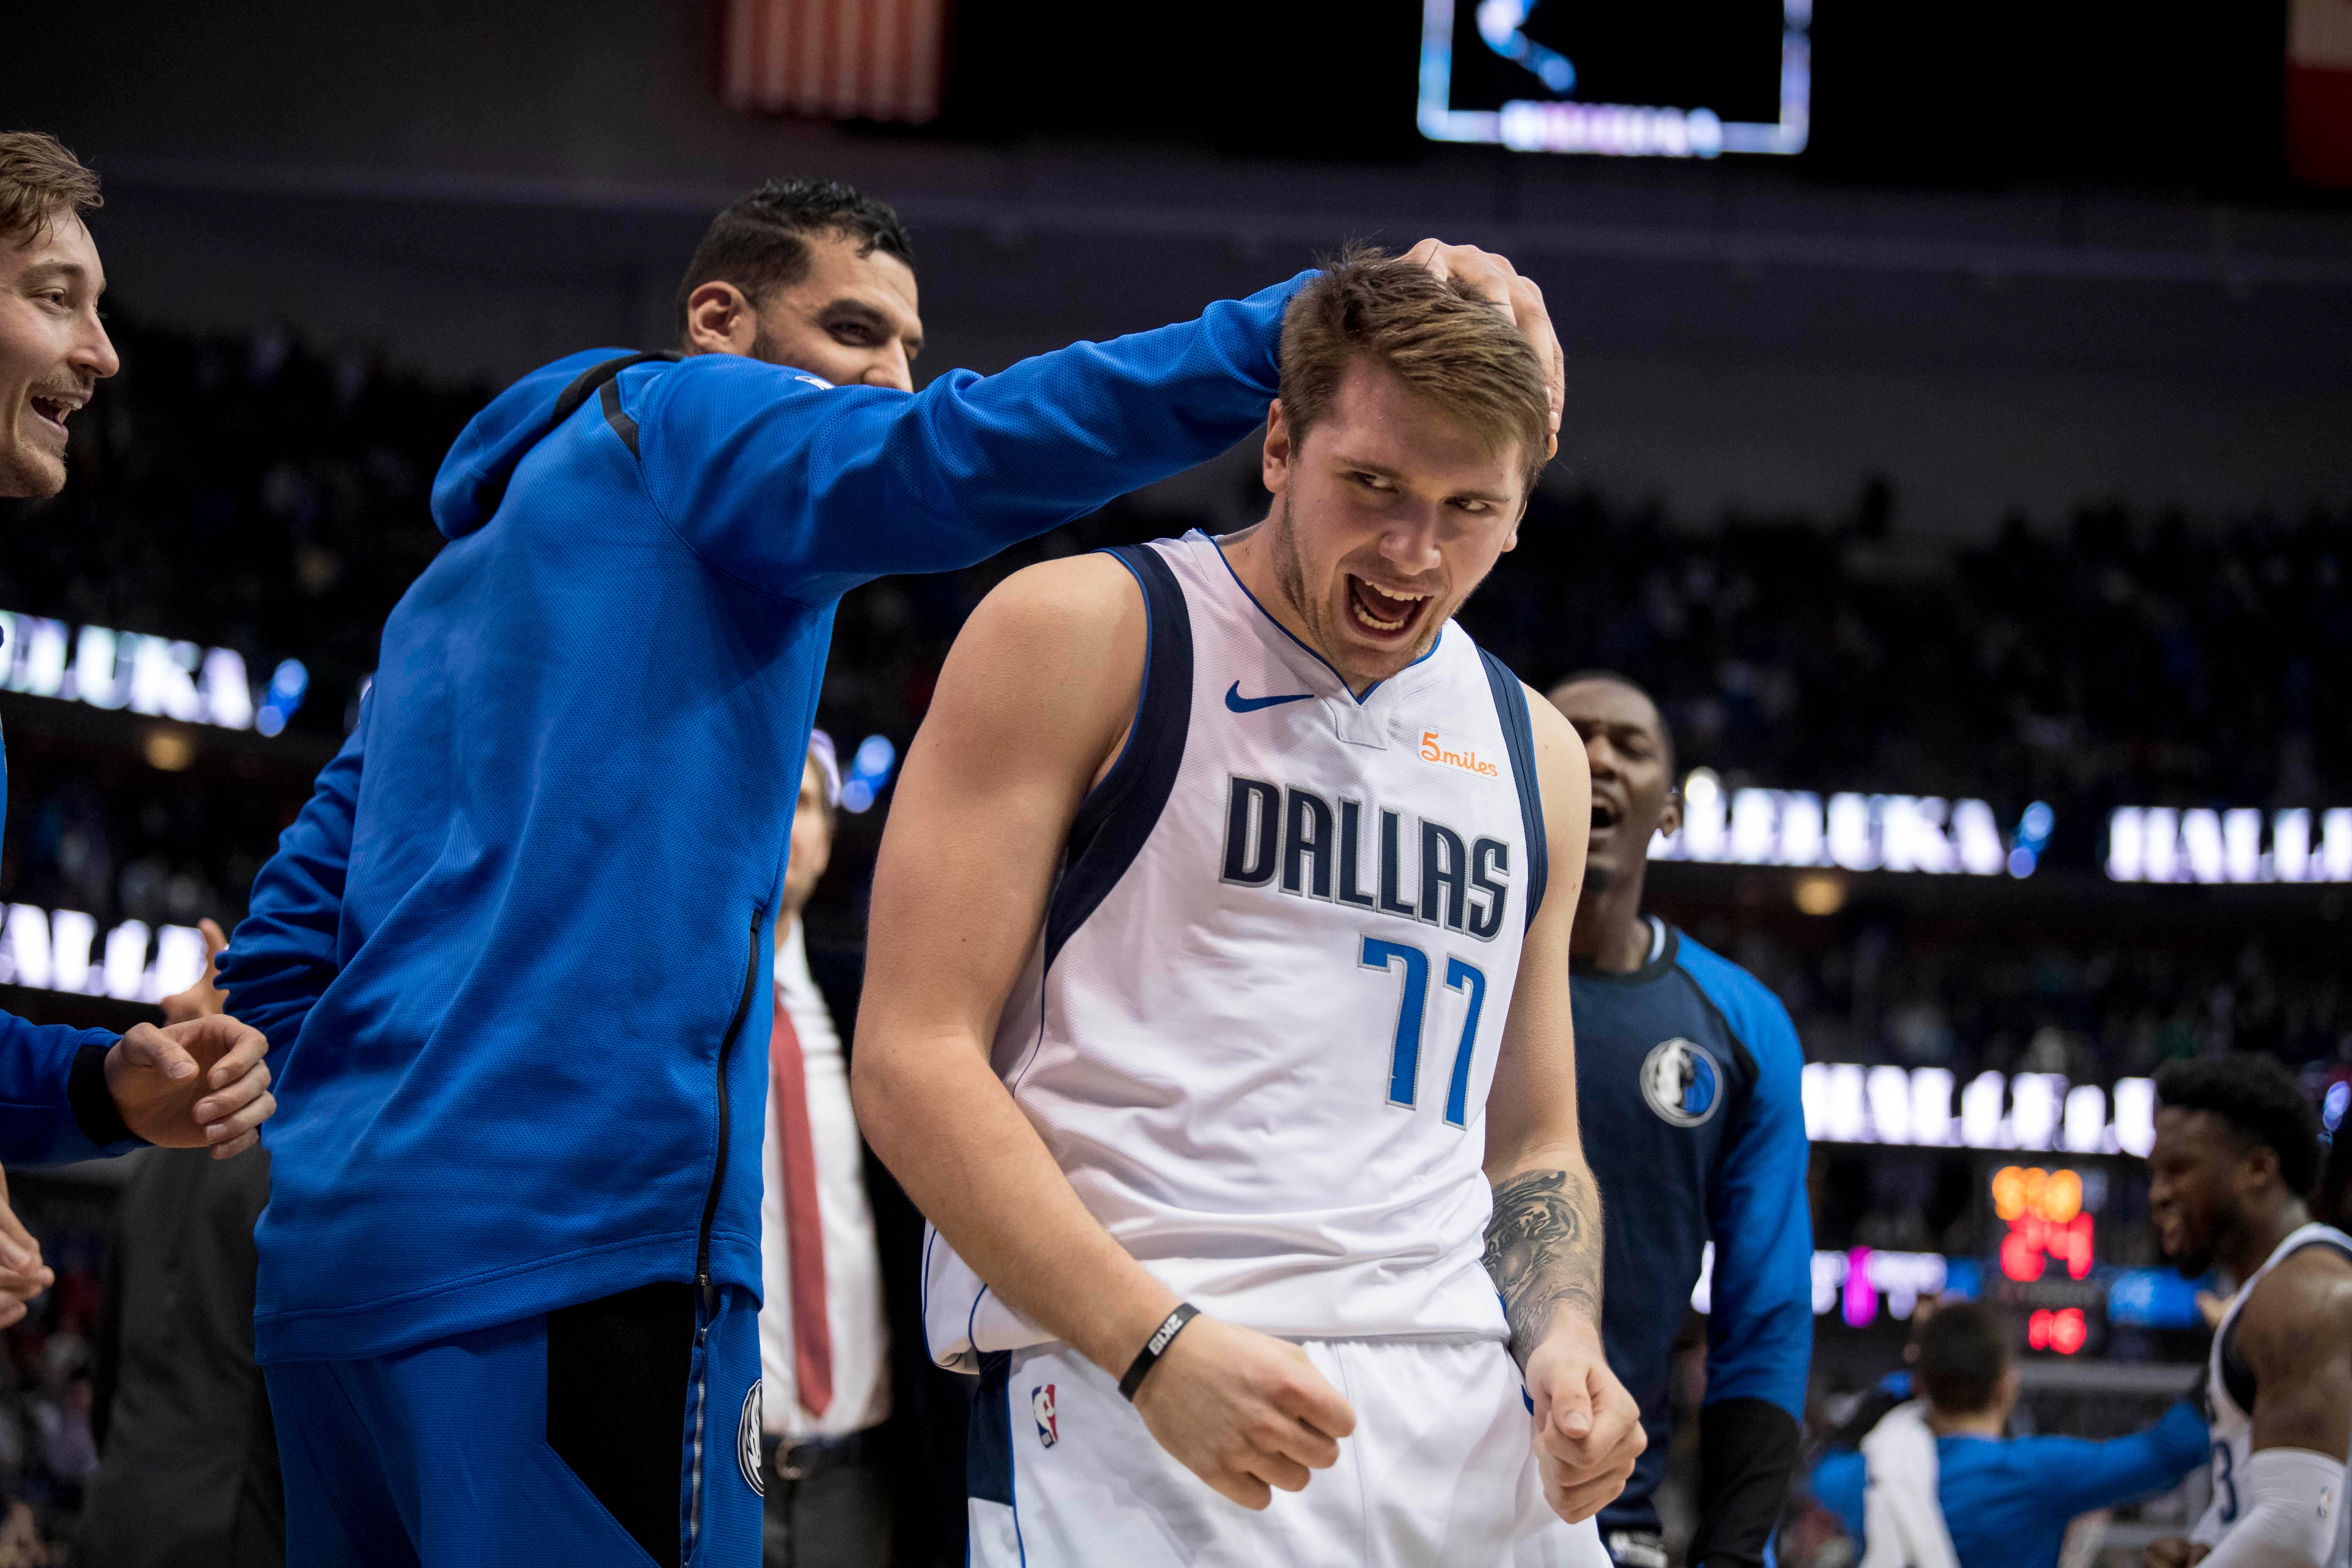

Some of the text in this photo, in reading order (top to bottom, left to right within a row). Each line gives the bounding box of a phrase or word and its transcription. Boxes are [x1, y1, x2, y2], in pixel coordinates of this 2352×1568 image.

[1421, 732, 1498, 777] 5miles
[1219, 773, 1511, 942] DALLAS
[1358, 932, 1488, 1130] 77
[1148, 1314, 1184, 1356] 2K19
